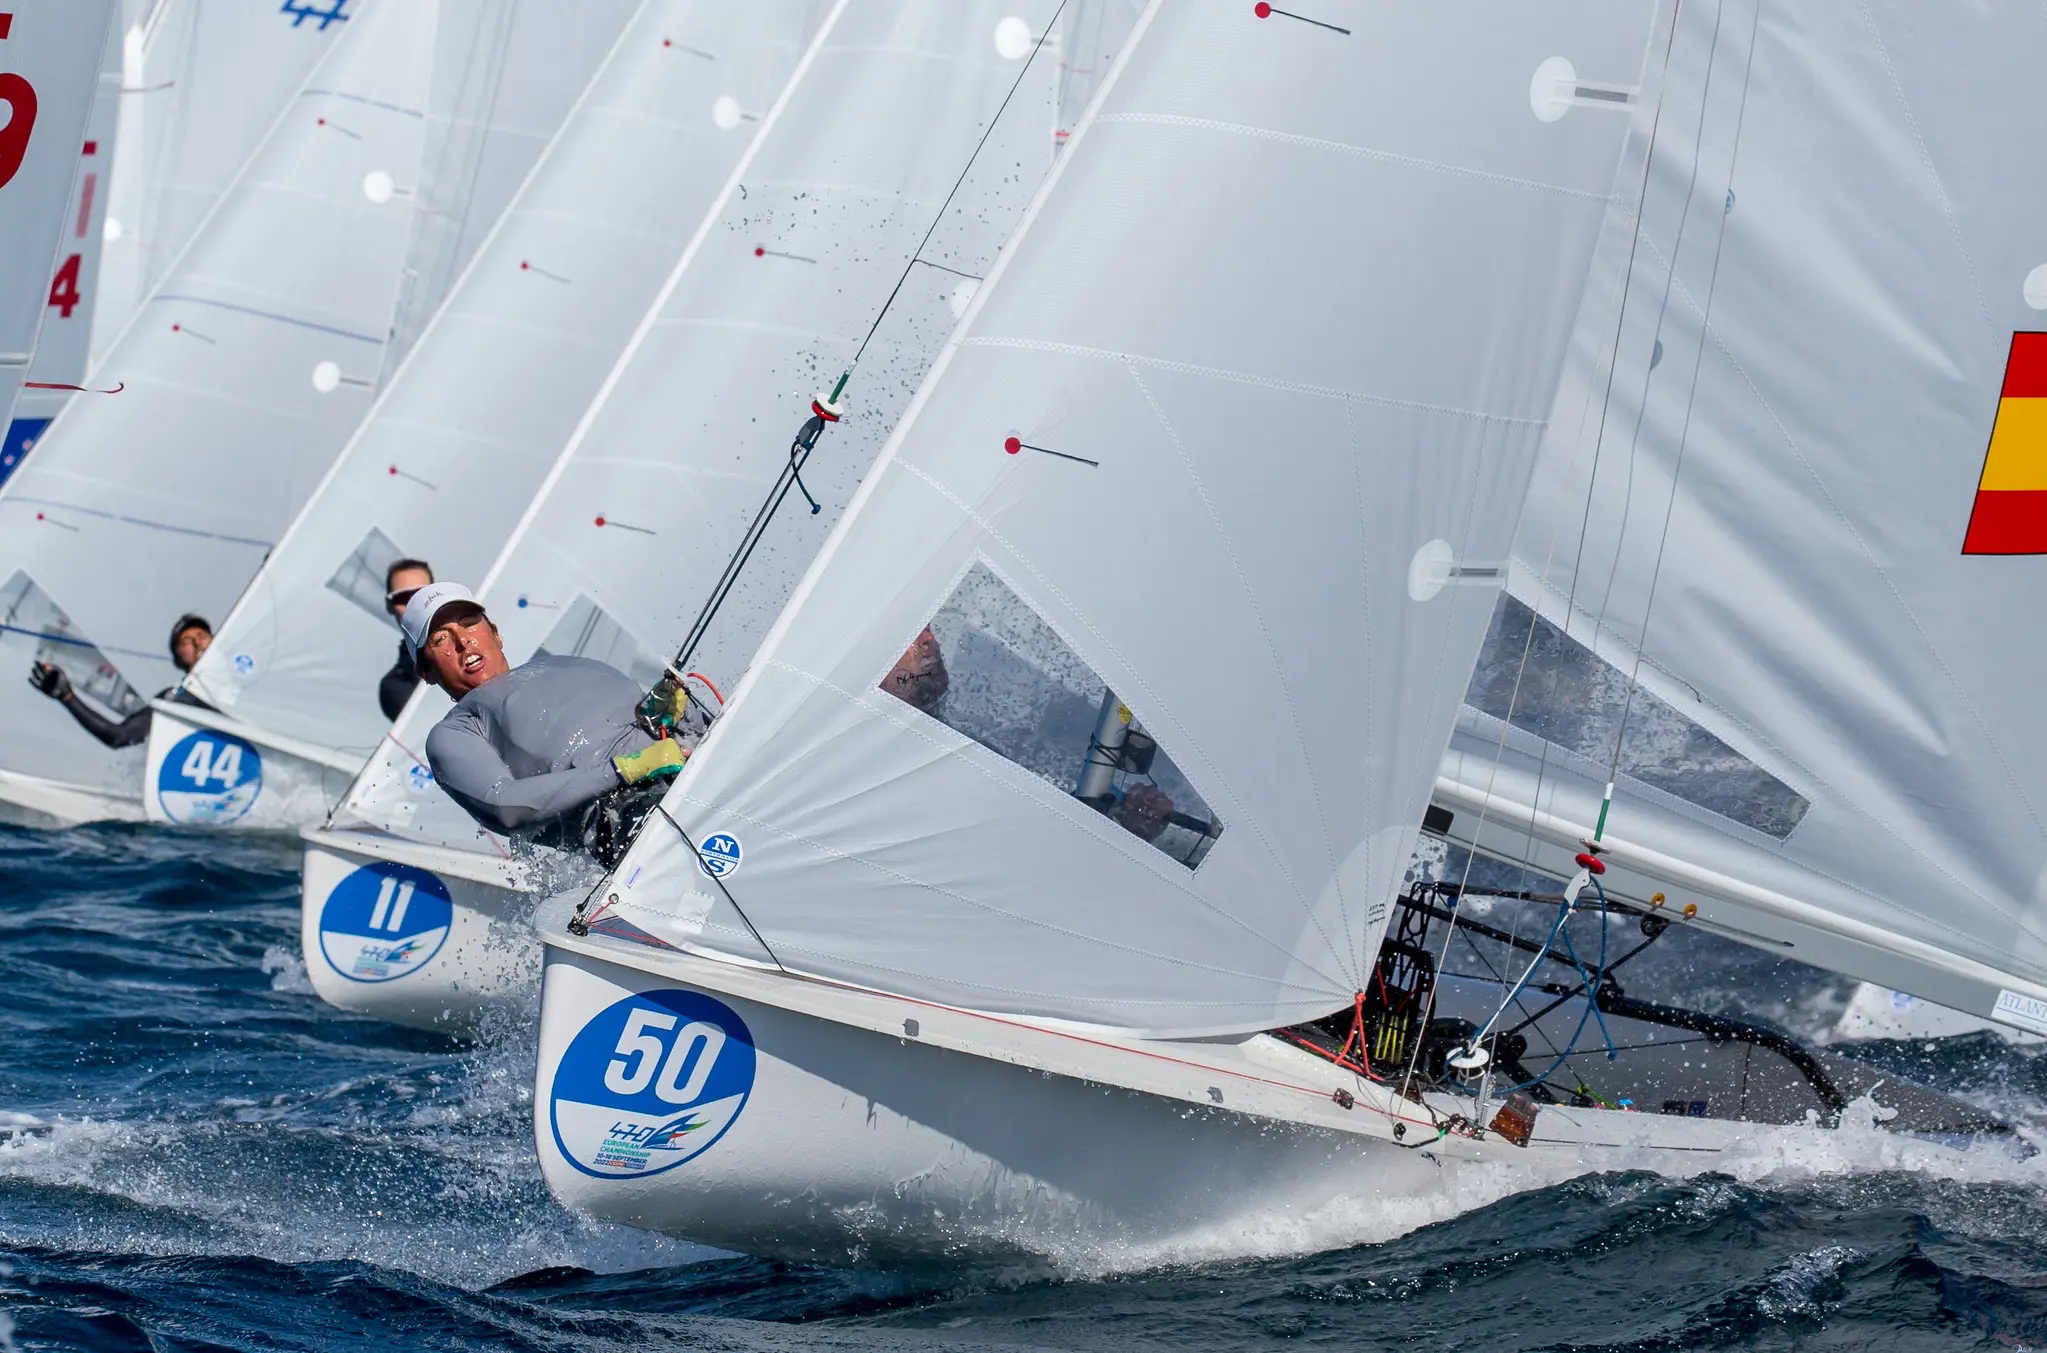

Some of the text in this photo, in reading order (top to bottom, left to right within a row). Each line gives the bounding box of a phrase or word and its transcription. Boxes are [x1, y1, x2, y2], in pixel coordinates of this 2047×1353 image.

[181, 740, 243, 789] 44
[369, 877, 417, 933] 11
[604, 1007, 727, 1104] 50
[609, 1121, 657, 1142] 470
[600, 1146, 651, 1158] CHAMPIONSHIP
[602, 1139, 640, 1150] EUROPEAN
[612, 1154, 648, 1164] SEPTEMBER
